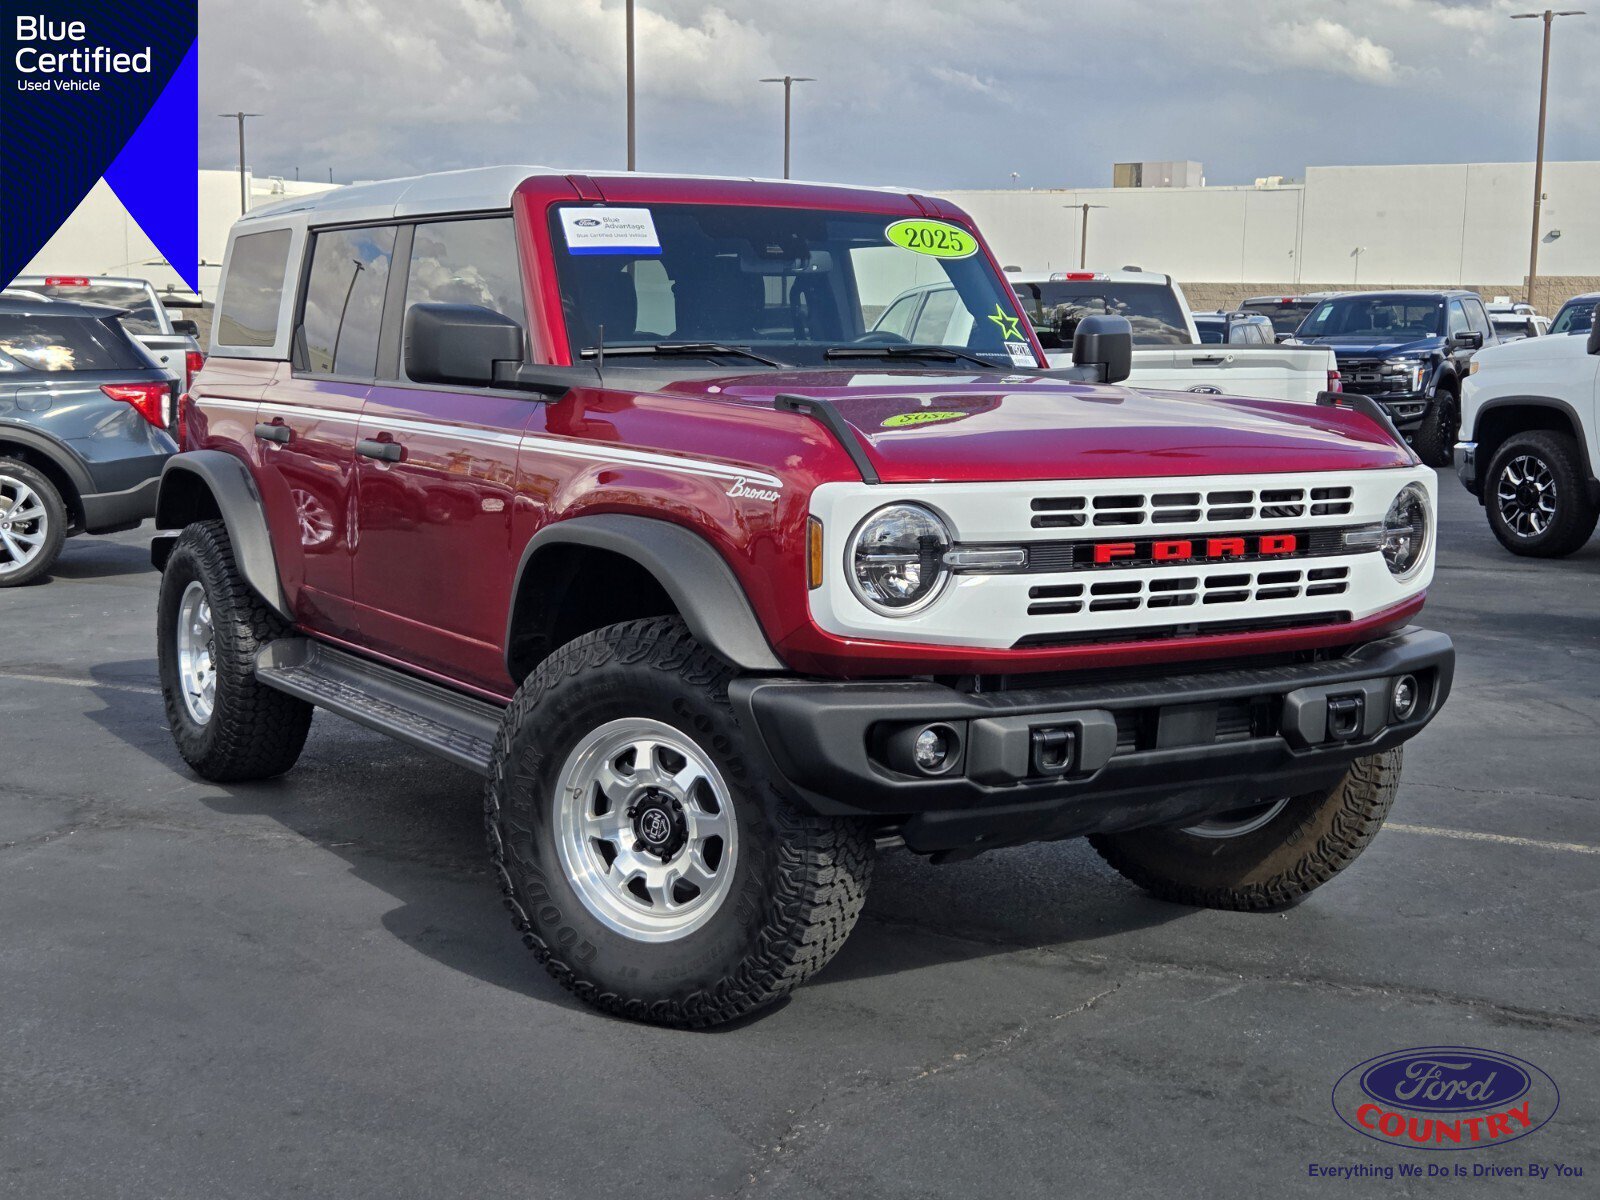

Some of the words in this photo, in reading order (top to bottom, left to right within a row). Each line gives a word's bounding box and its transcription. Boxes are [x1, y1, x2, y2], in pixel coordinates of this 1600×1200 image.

[905, 228, 963, 251] 2025
[726, 476, 781, 501] Bronco
[1094, 535, 1297, 563] FORD
[649, 812, 662, 840] ICON
